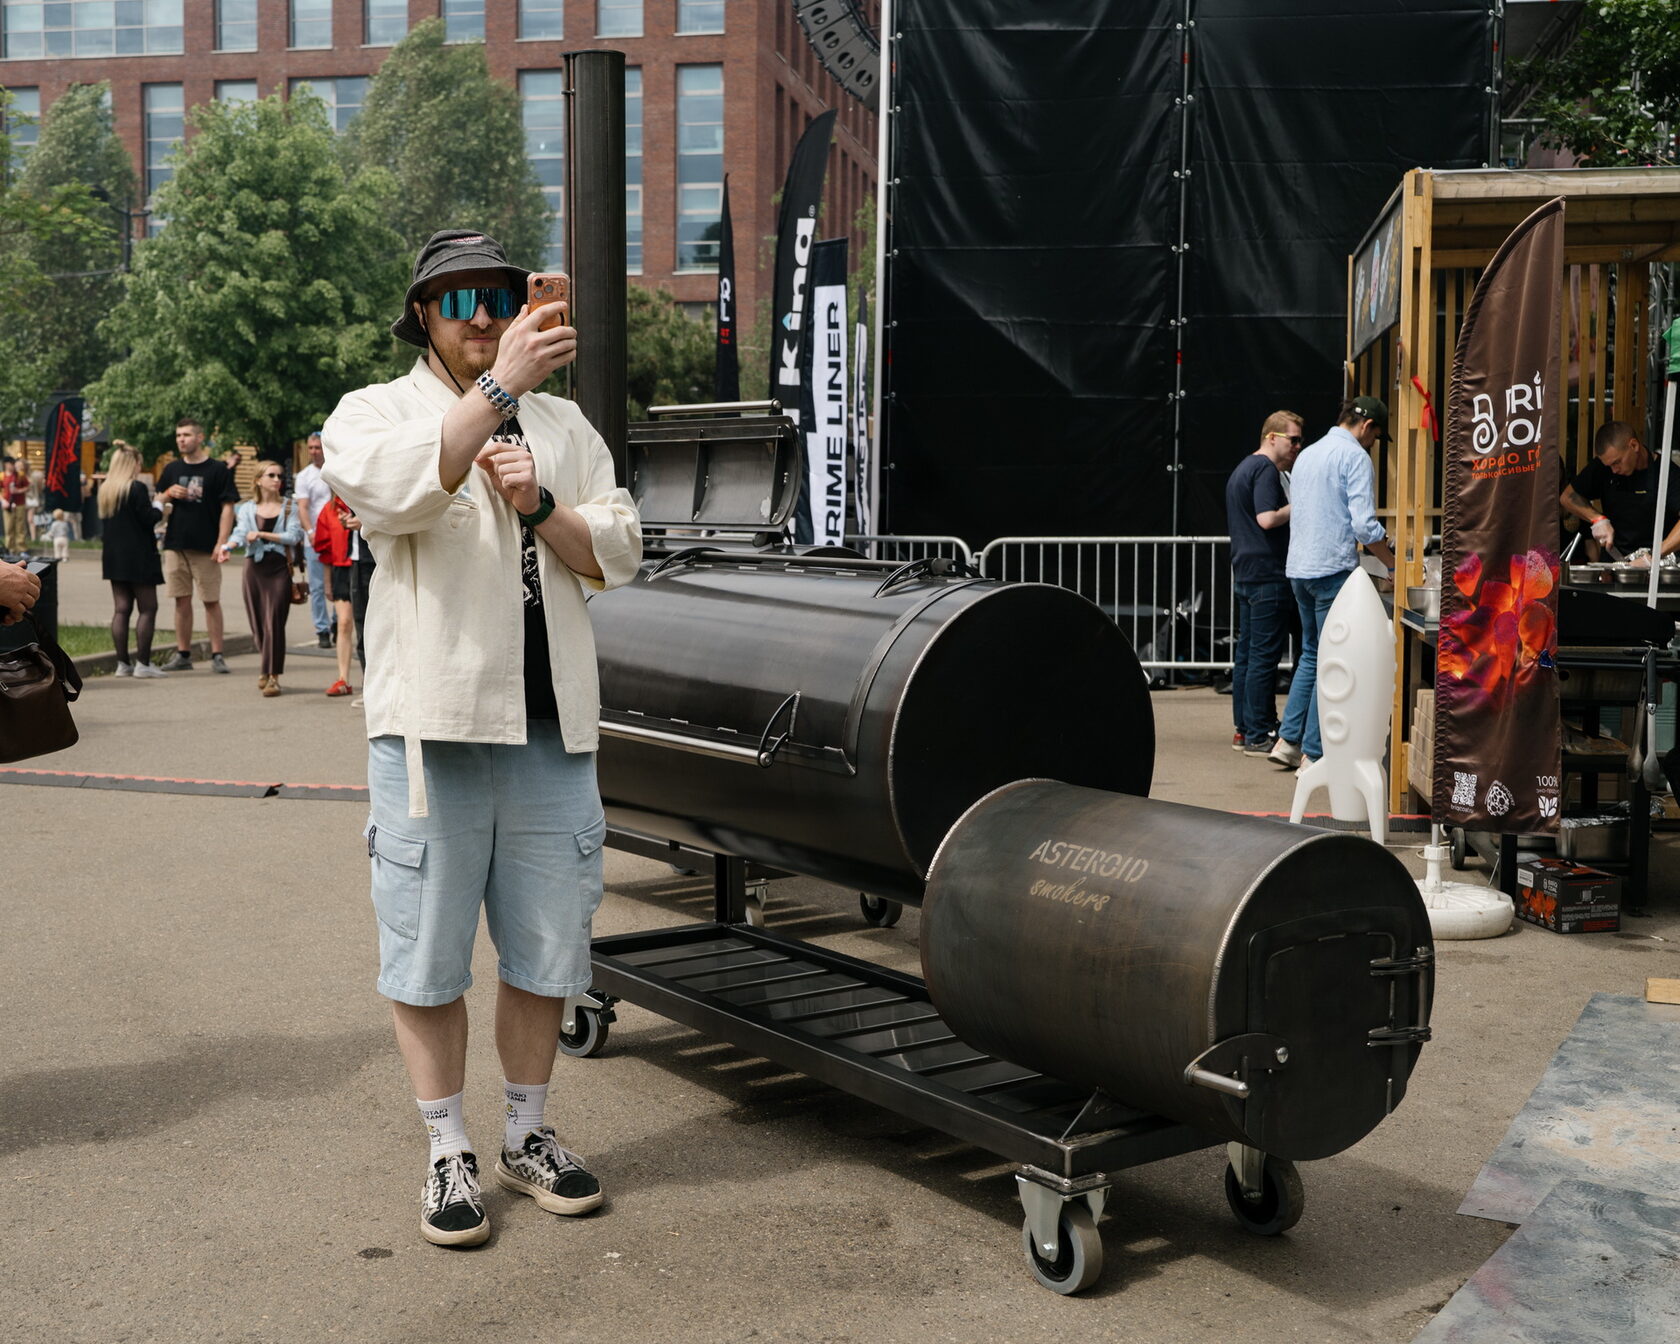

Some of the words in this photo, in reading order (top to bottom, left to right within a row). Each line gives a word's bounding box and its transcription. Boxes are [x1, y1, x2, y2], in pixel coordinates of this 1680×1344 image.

[827, 301, 842, 426] LINER
[825, 436, 842, 546] RIME
[1535, 775, 1558, 787] 100%
[1028, 839, 1149, 883] ASTEROID
[1030, 876, 1111, 912] smokers
